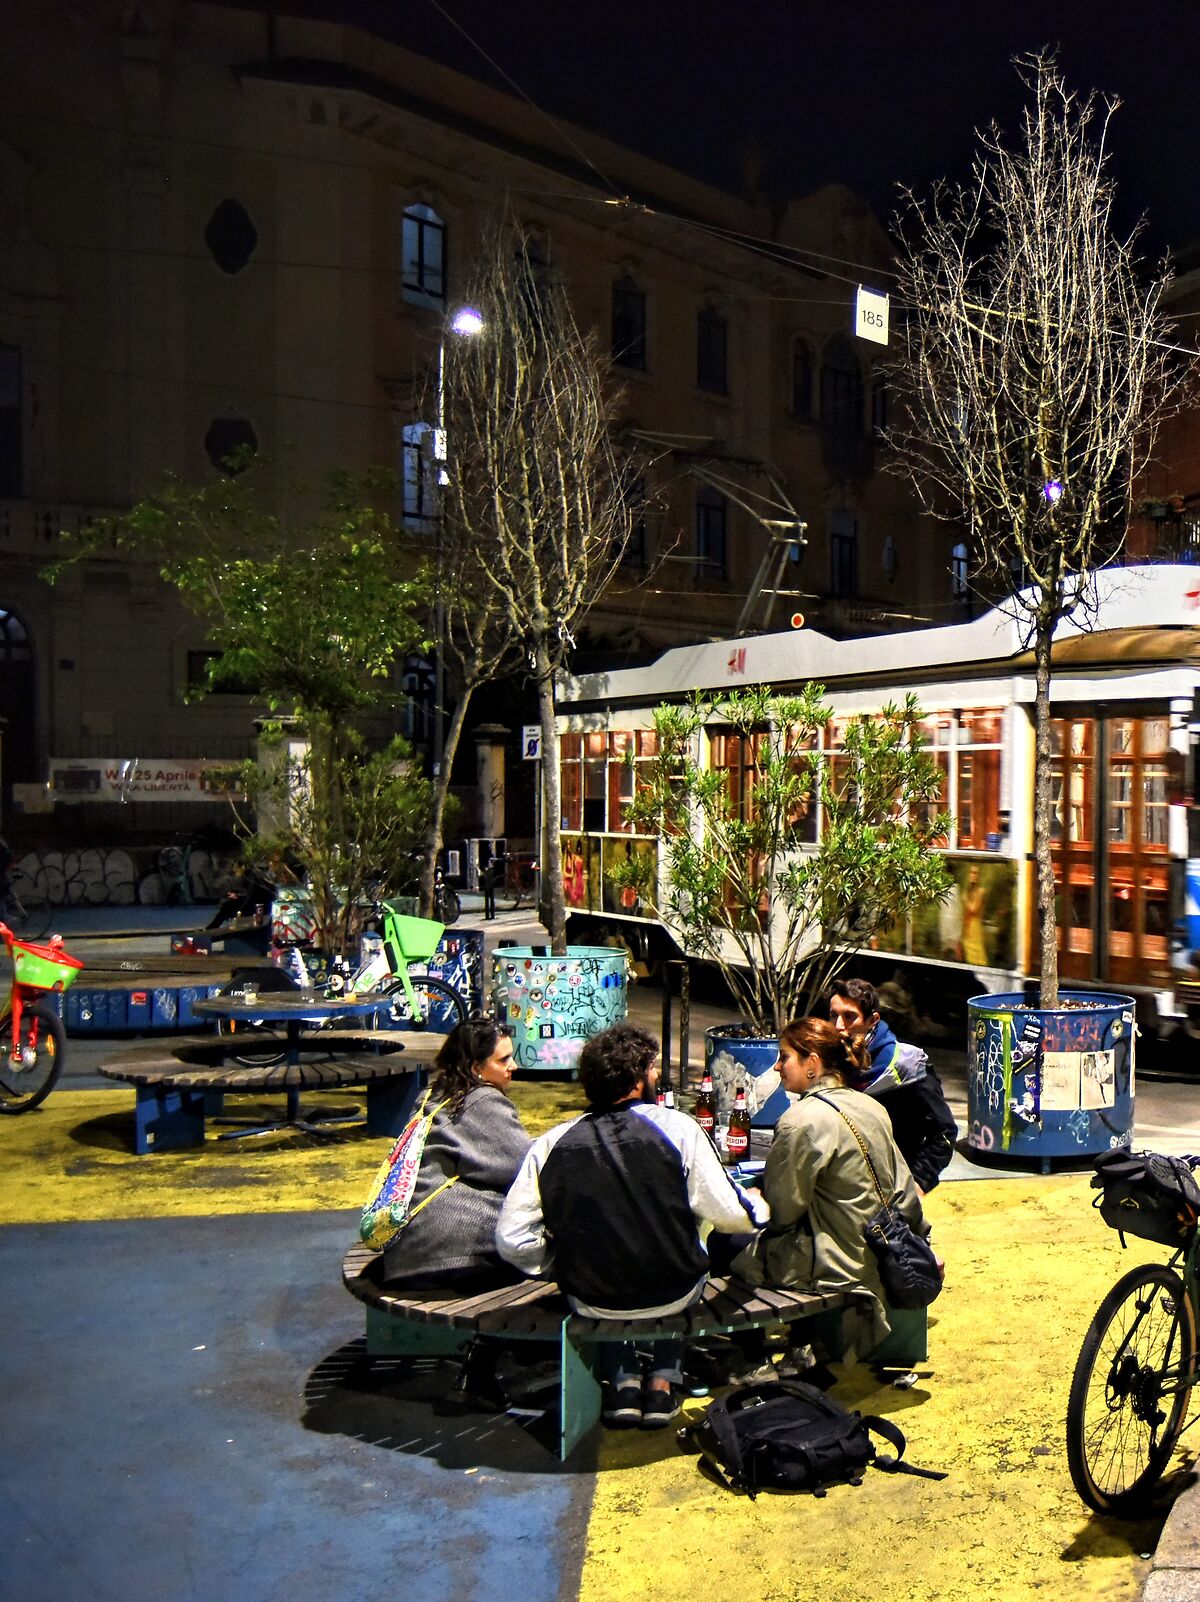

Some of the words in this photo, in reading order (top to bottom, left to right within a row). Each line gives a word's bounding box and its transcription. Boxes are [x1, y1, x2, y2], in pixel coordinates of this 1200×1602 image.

[862, 310, 883, 328] 185
[135, 770, 151, 781] 25
[155, 770, 197, 783] Aprile
[698, 1118, 713, 1126] RONI
[726, 1135, 747, 1145] PERONI
